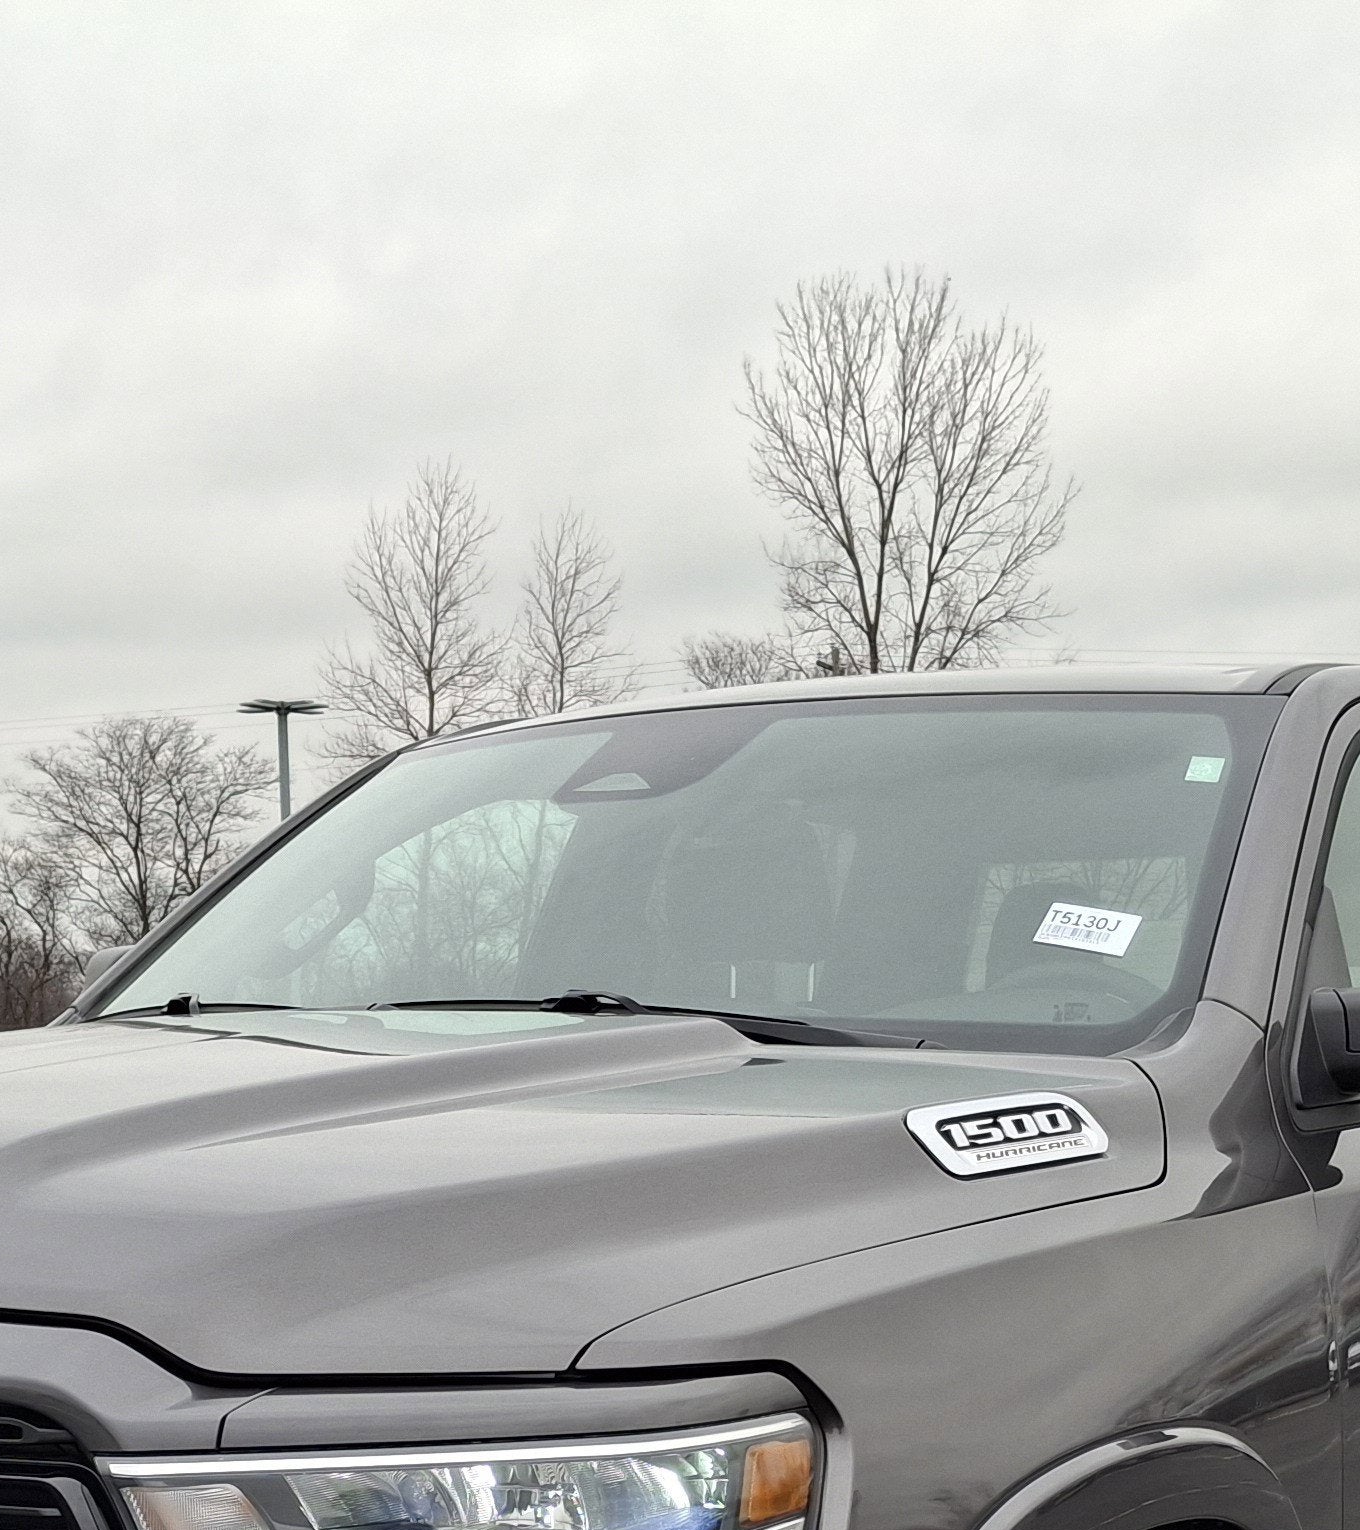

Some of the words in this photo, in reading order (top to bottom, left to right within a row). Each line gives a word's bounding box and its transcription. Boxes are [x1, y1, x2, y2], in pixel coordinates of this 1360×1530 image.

[1050, 909, 1122, 932] T5130J
[941, 1108, 1073, 1148] 1500
[976, 1138, 1086, 1162] HURRICANE
